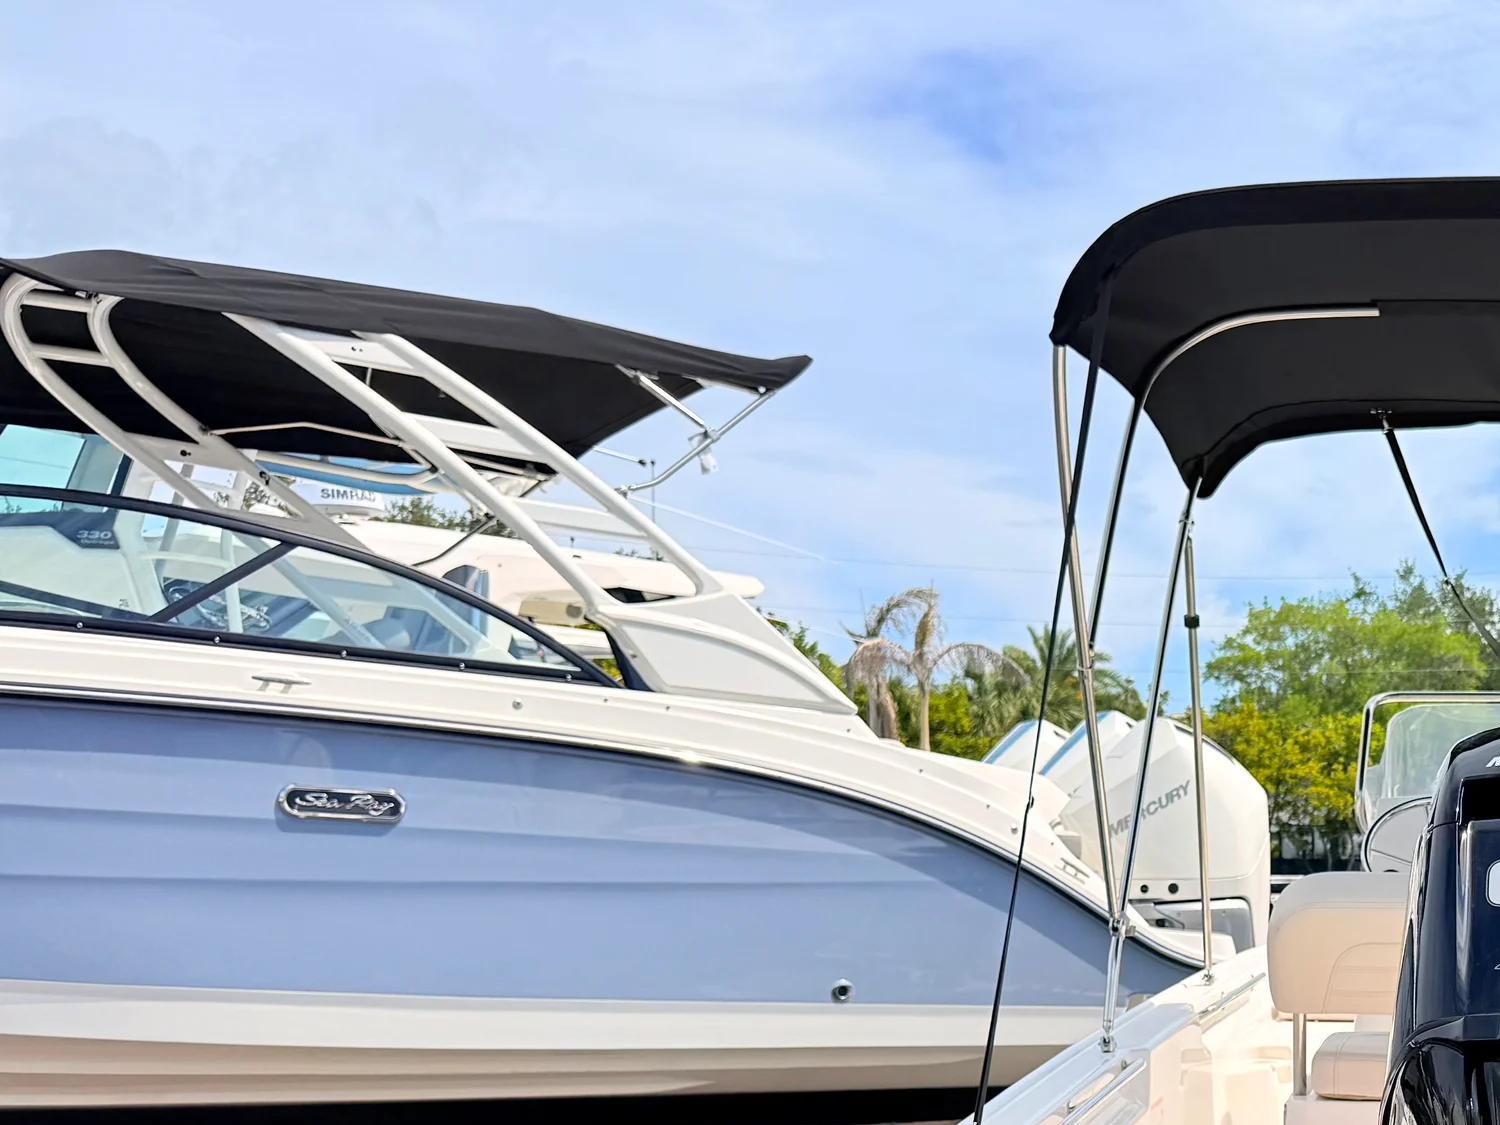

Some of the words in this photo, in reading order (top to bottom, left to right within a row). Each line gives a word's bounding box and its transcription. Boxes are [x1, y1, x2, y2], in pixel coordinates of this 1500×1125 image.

[320, 488, 377, 503] SIMRAD
[77, 530, 113, 540] 330
[294, 792, 344, 809] Sea
[345, 794, 395, 817] Ray
